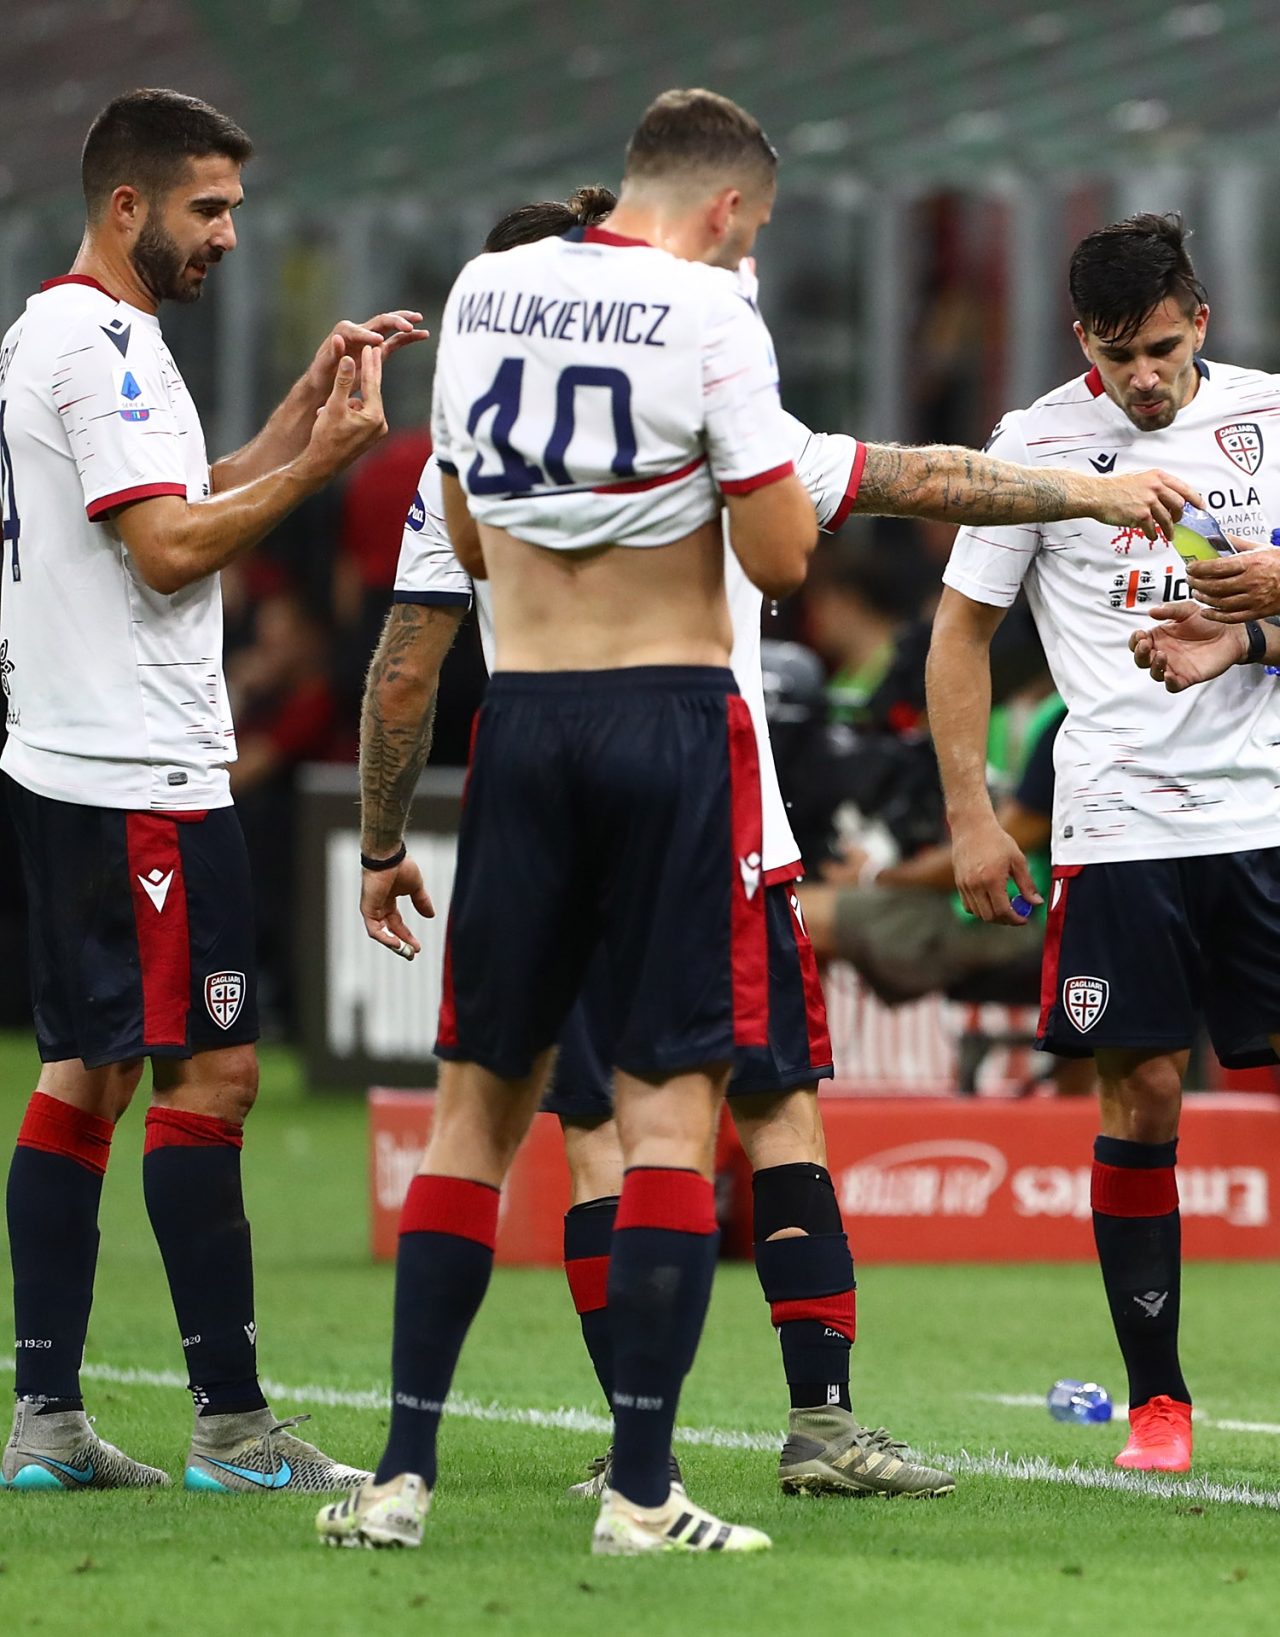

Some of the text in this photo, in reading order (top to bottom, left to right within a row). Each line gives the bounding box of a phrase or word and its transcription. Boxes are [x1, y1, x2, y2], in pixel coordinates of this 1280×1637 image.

[457, 290, 671, 347] WALUKIEWICZ
[466, 357, 637, 496] 40
[1206, 486, 1261, 510] OLA
[211, 976, 241, 986] CAGLIARI
[1070, 980, 1103, 991] CAGLIARI
[25, 1339, 53, 1349] 1920
